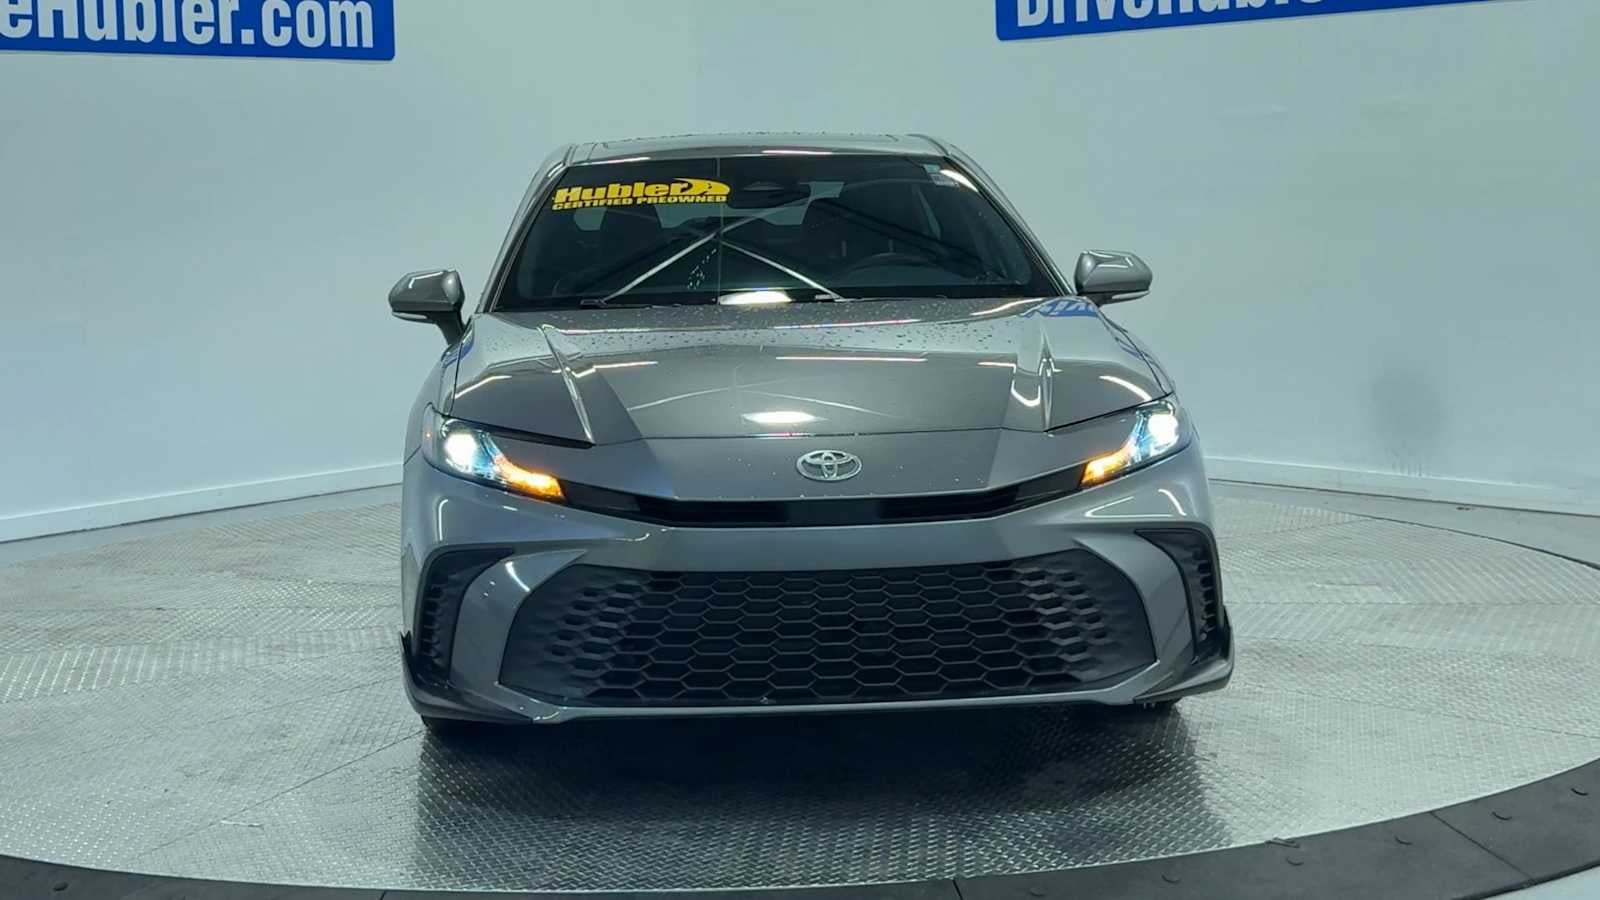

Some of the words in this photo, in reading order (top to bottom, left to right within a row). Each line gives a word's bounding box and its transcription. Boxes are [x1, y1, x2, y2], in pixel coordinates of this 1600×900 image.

[553, 182, 690, 203] Hubler
[552, 197, 633, 211] CERTIFIED
[636, 195, 728, 205] PREOWNED
